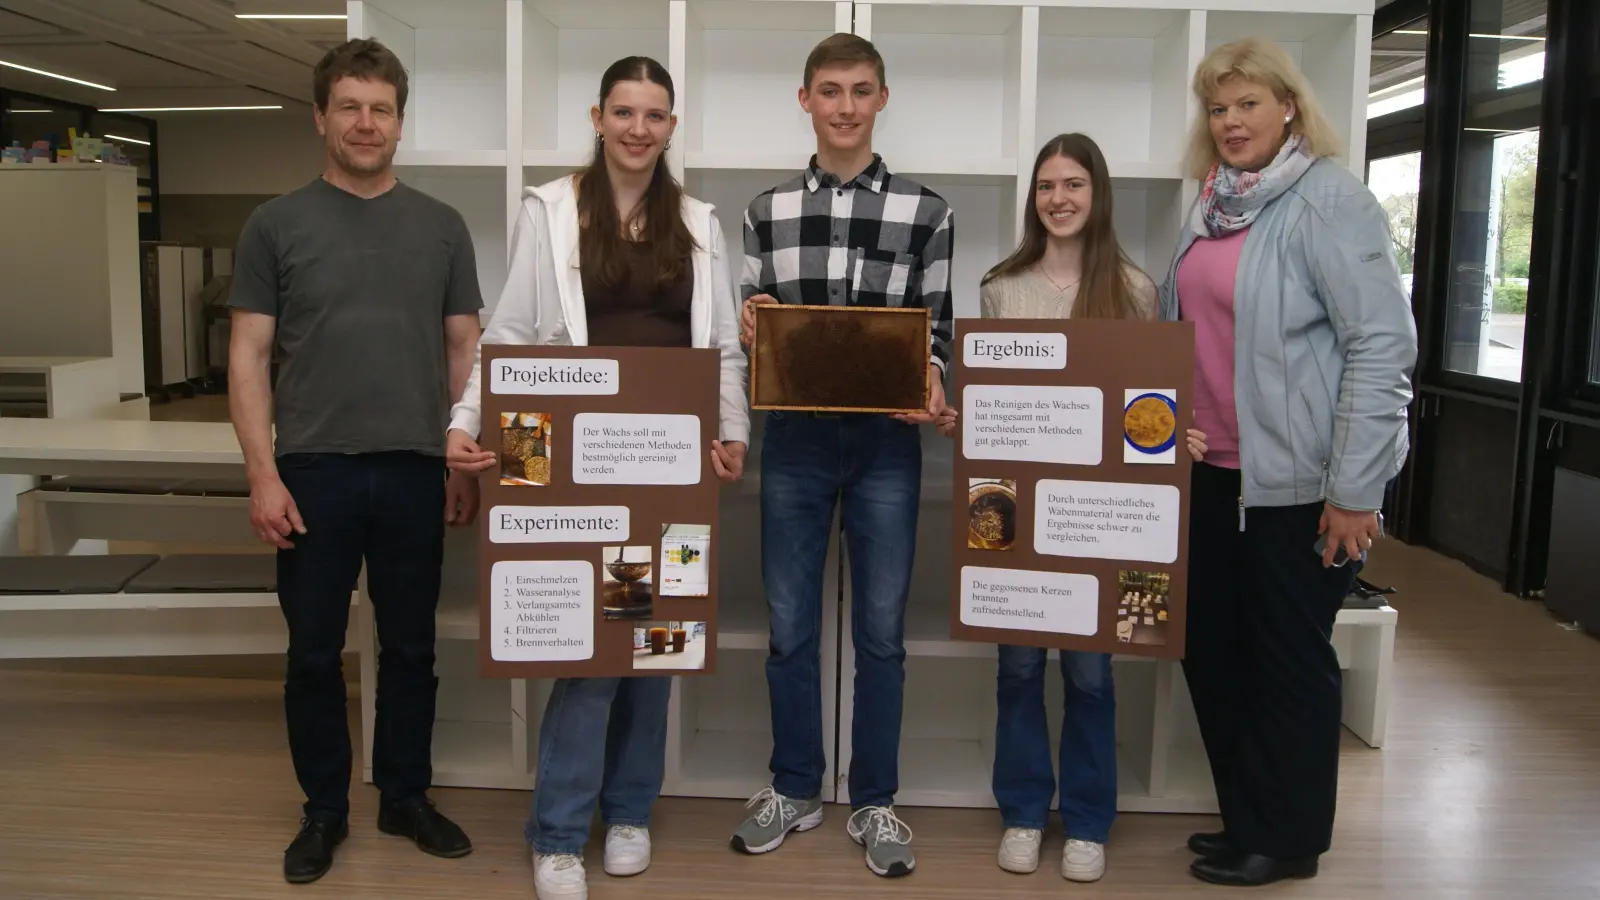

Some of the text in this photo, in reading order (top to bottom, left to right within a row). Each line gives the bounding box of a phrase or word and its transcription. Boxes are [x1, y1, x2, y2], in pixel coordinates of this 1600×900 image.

[973, 340, 1055, 360] Ergebnis:
[501, 366, 609, 387] Projektidee:
[975, 400, 1090, 411] Das Reinigen des Wachses
[975, 412, 1050, 423] hat insgesamt mit
[583, 428, 666, 437] Der Wachs soll mit
[975, 425, 1082, 435] verschiedenen Methoden
[582, 440, 692, 450] verschiedenen Methoden
[975, 437, 1030, 448] gut geklappt.
[582, 453, 677, 464] bestmöglich gereinigt
[582, 465, 616, 474] werden.
[1048, 494, 1155, 508] Durch unterschiedliches
[1048, 507, 1160, 521] Wabenmaterial waren die
[500, 514, 619, 535] Experimente:
[1047, 520, 1094, 531] Ergebnisse
[1097, 523, 1128, 532] schwer
[1047, 532, 1100, 544] vergleichen.
[505, 576, 578, 584] 1. Einschmelzen
[504, 588, 581, 598] 2. Wasseranalyse
[973, 581, 1072, 596] Die gegossenen Kerzen
[972, 593, 1009, 604] brannten
[504, 601, 581, 611] 3. Verlangsamtes
[516, 613, 560, 622] Abkühlen
[972, 606, 1047, 619] zufriedenstellend.
[504, 626, 557, 635] 4. Filtrieren
[504, 638, 584, 647] 5. Brennverhalten
